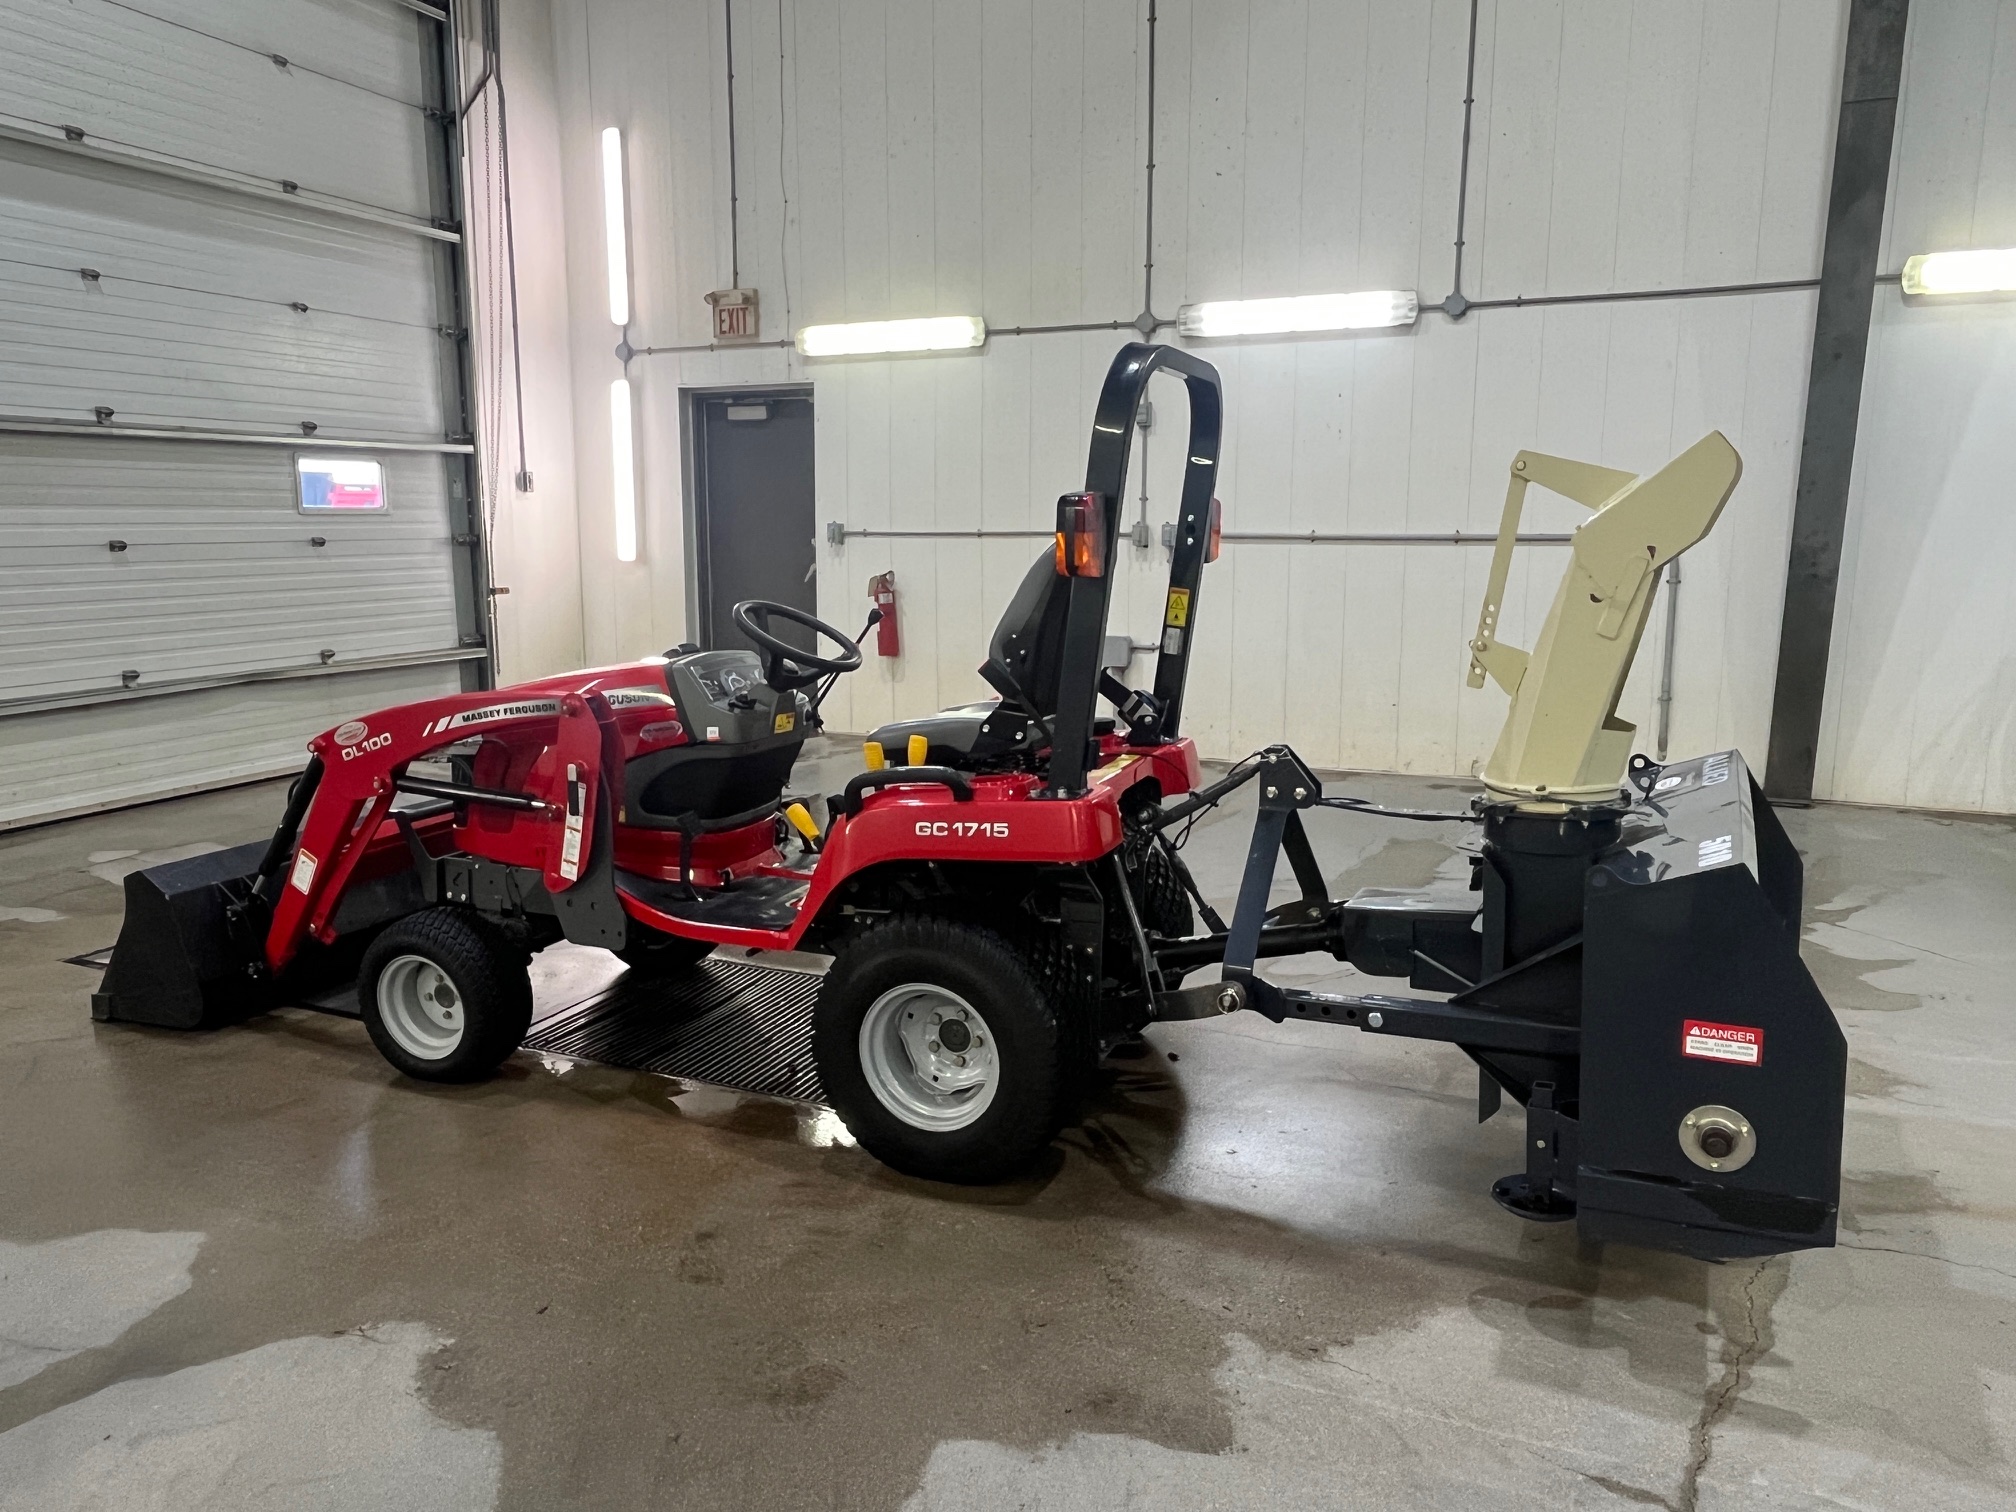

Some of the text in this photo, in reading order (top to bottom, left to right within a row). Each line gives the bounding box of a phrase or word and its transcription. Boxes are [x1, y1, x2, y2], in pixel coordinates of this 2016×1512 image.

[719, 307, 748, 335] EXIT
[608, 693, 650, 706] GUSON
[462, 703, 556, 722] MASSEY FERGUSON
[341, 732, 392, 762] DL100
[1701, 1027, 1755, 1043] DANGER
